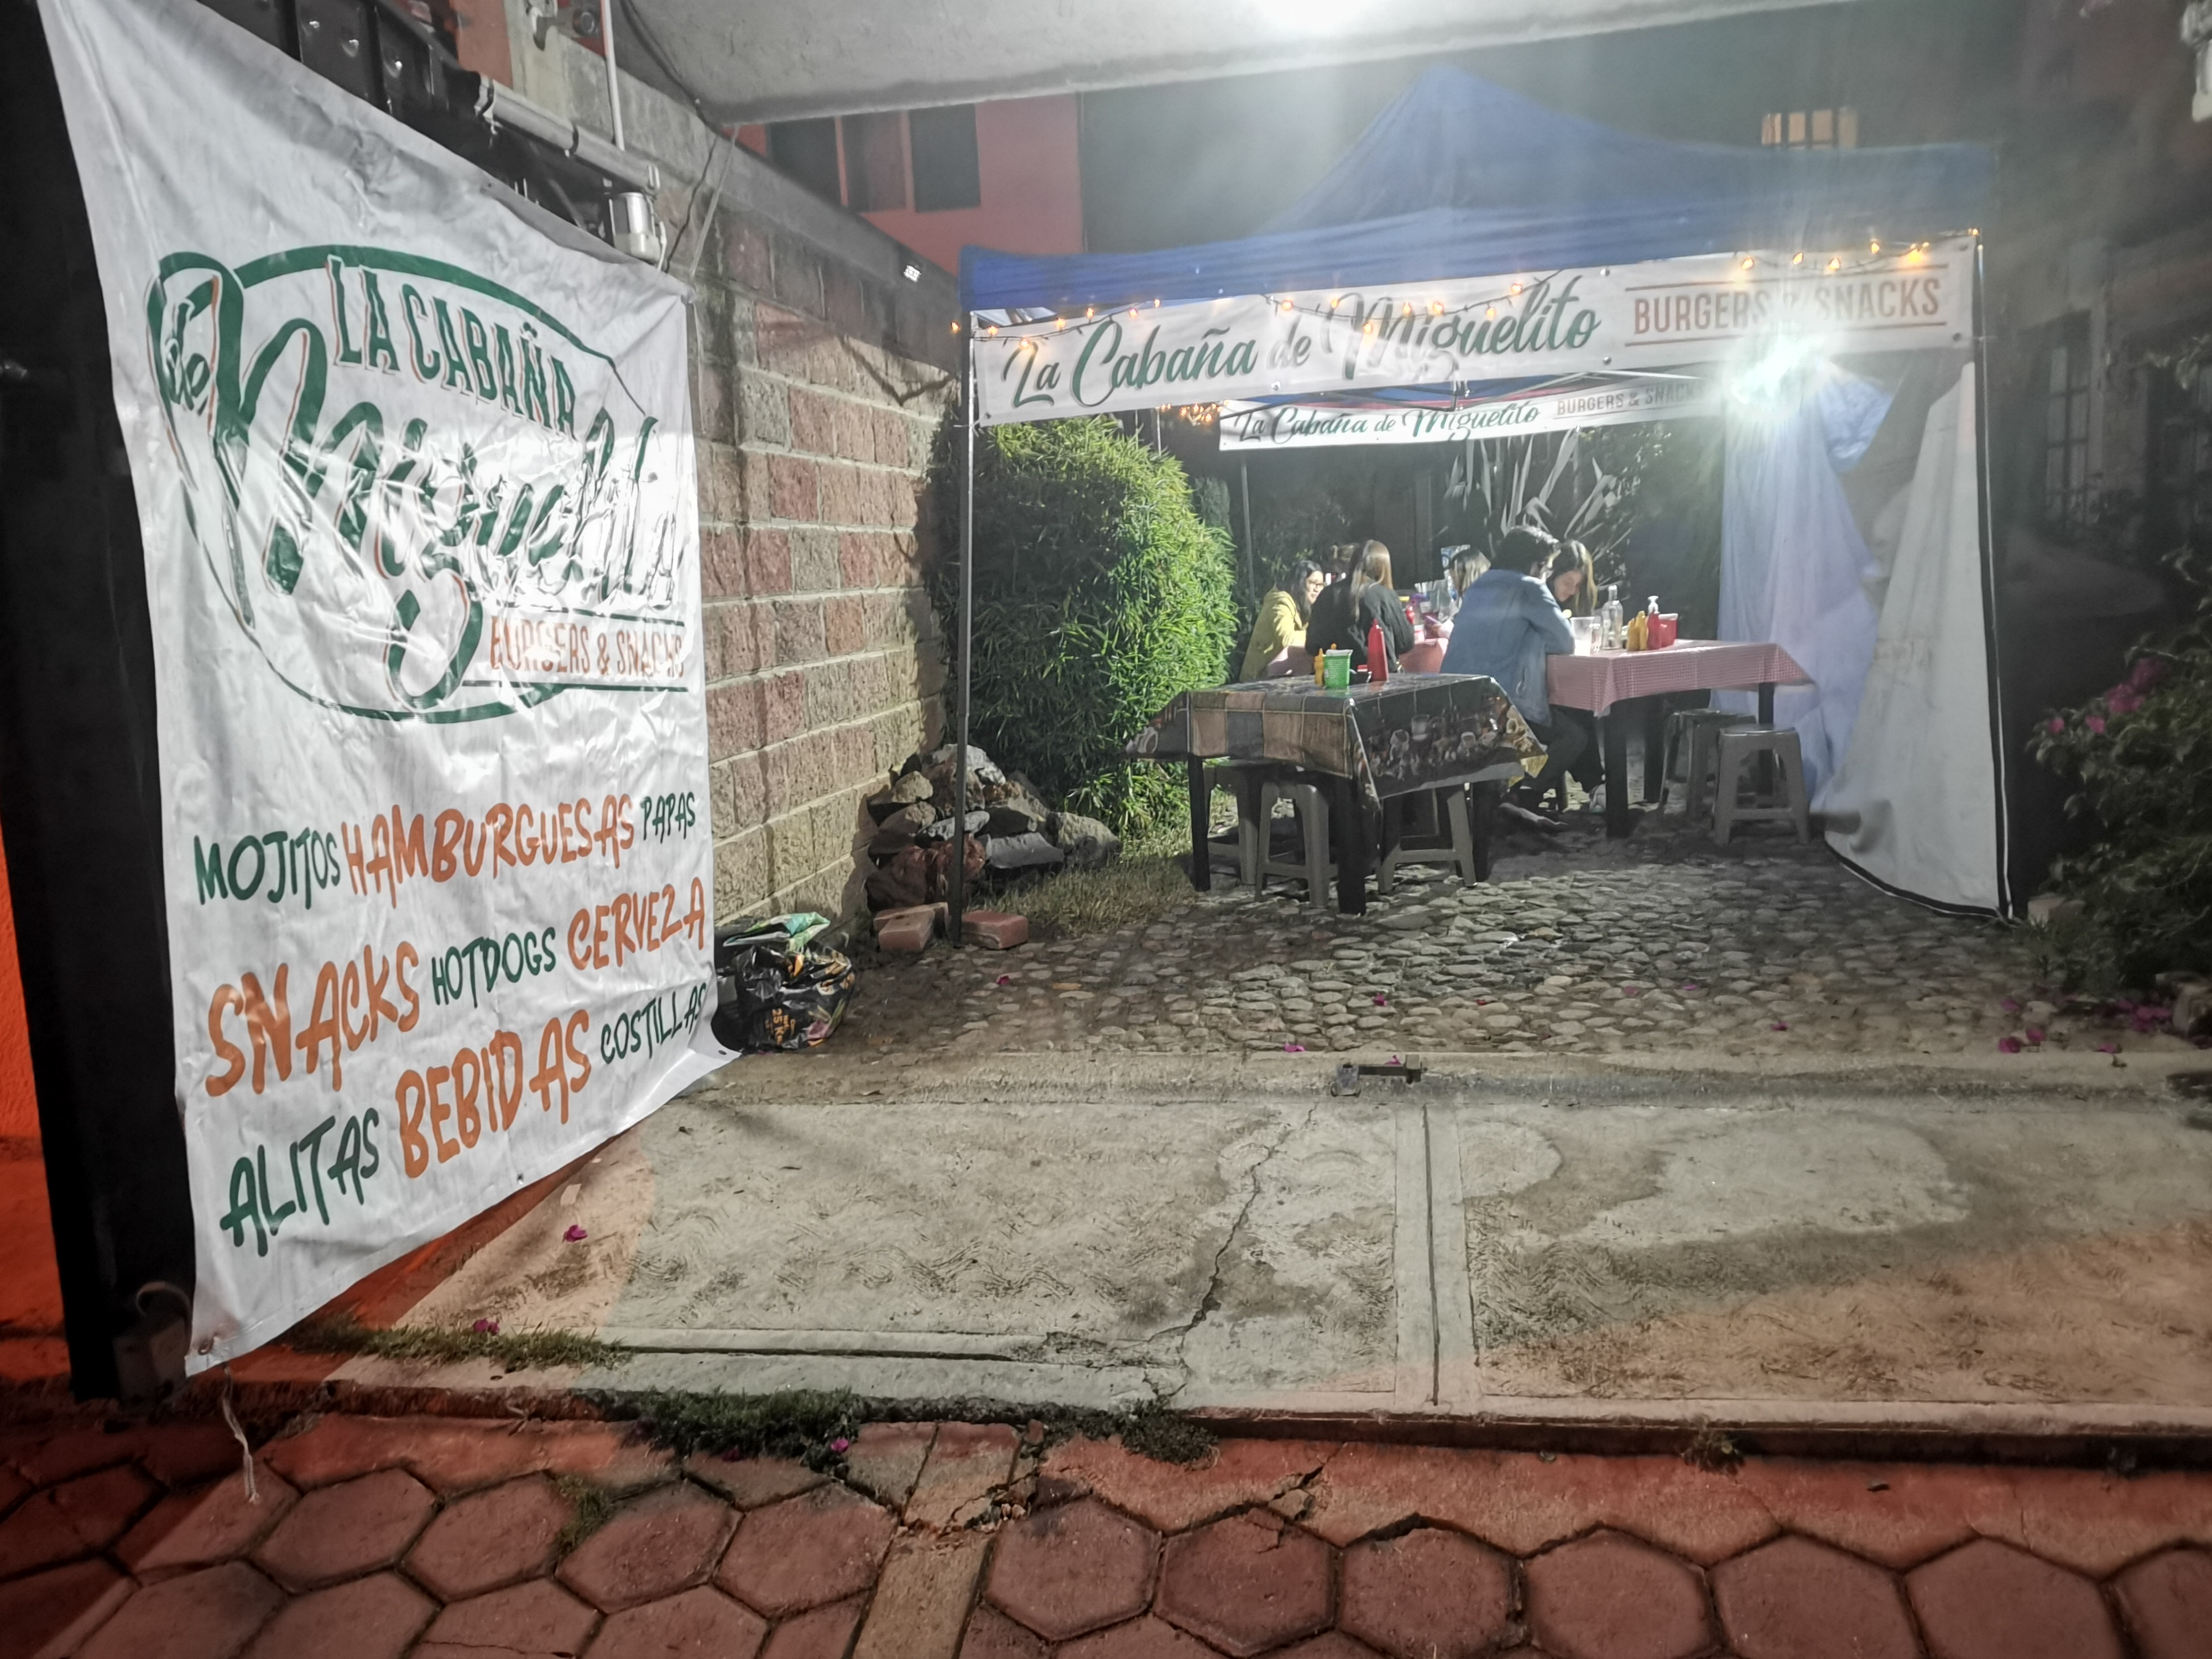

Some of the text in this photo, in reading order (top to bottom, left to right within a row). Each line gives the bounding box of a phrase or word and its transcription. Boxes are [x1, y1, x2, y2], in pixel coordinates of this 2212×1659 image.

[326, 257, 578, 440] LA CABAÑA
[1002, 275, 1602, 409] La Cabaña de Miguelito
[1634, 289, 1771, 335] BURGERS
[1814, 278, 1940, 321] SNACKS
[1234, 400, 1542, 445] La Cabaña de Miguelito
[1557, 393, 1624, 415] BURGERS
[1629, 391, 1640, 407] &
[490, 615, 590, 673] BURGERS
[597, 632, 611, 675] &
[194, 791, 696, 910] MOJITOS HAMBURGUESAS PAPAS
[205, 877, 706, 1097] SNACKS HOTDOGS CERVEZA
[220, 982, 707, 1257] ALITAS BEBIDAS COSTILLAS
